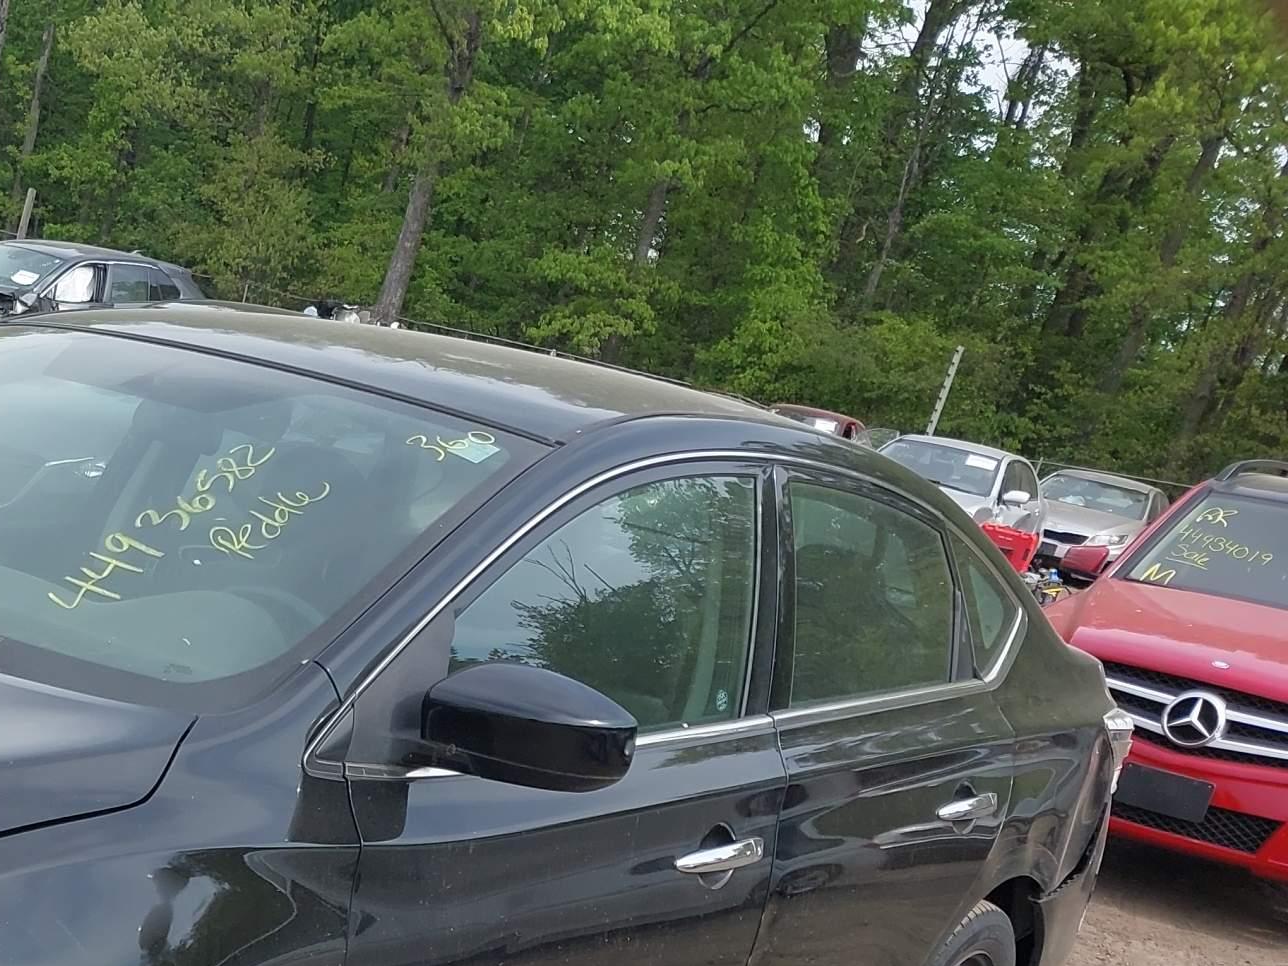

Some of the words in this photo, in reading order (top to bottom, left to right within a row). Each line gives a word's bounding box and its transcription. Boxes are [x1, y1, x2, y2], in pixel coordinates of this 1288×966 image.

[405, 431, 495, 462] 360
[1179, 524, 1273, 566] 44934019
[1139, 562, 1177, 585] M
